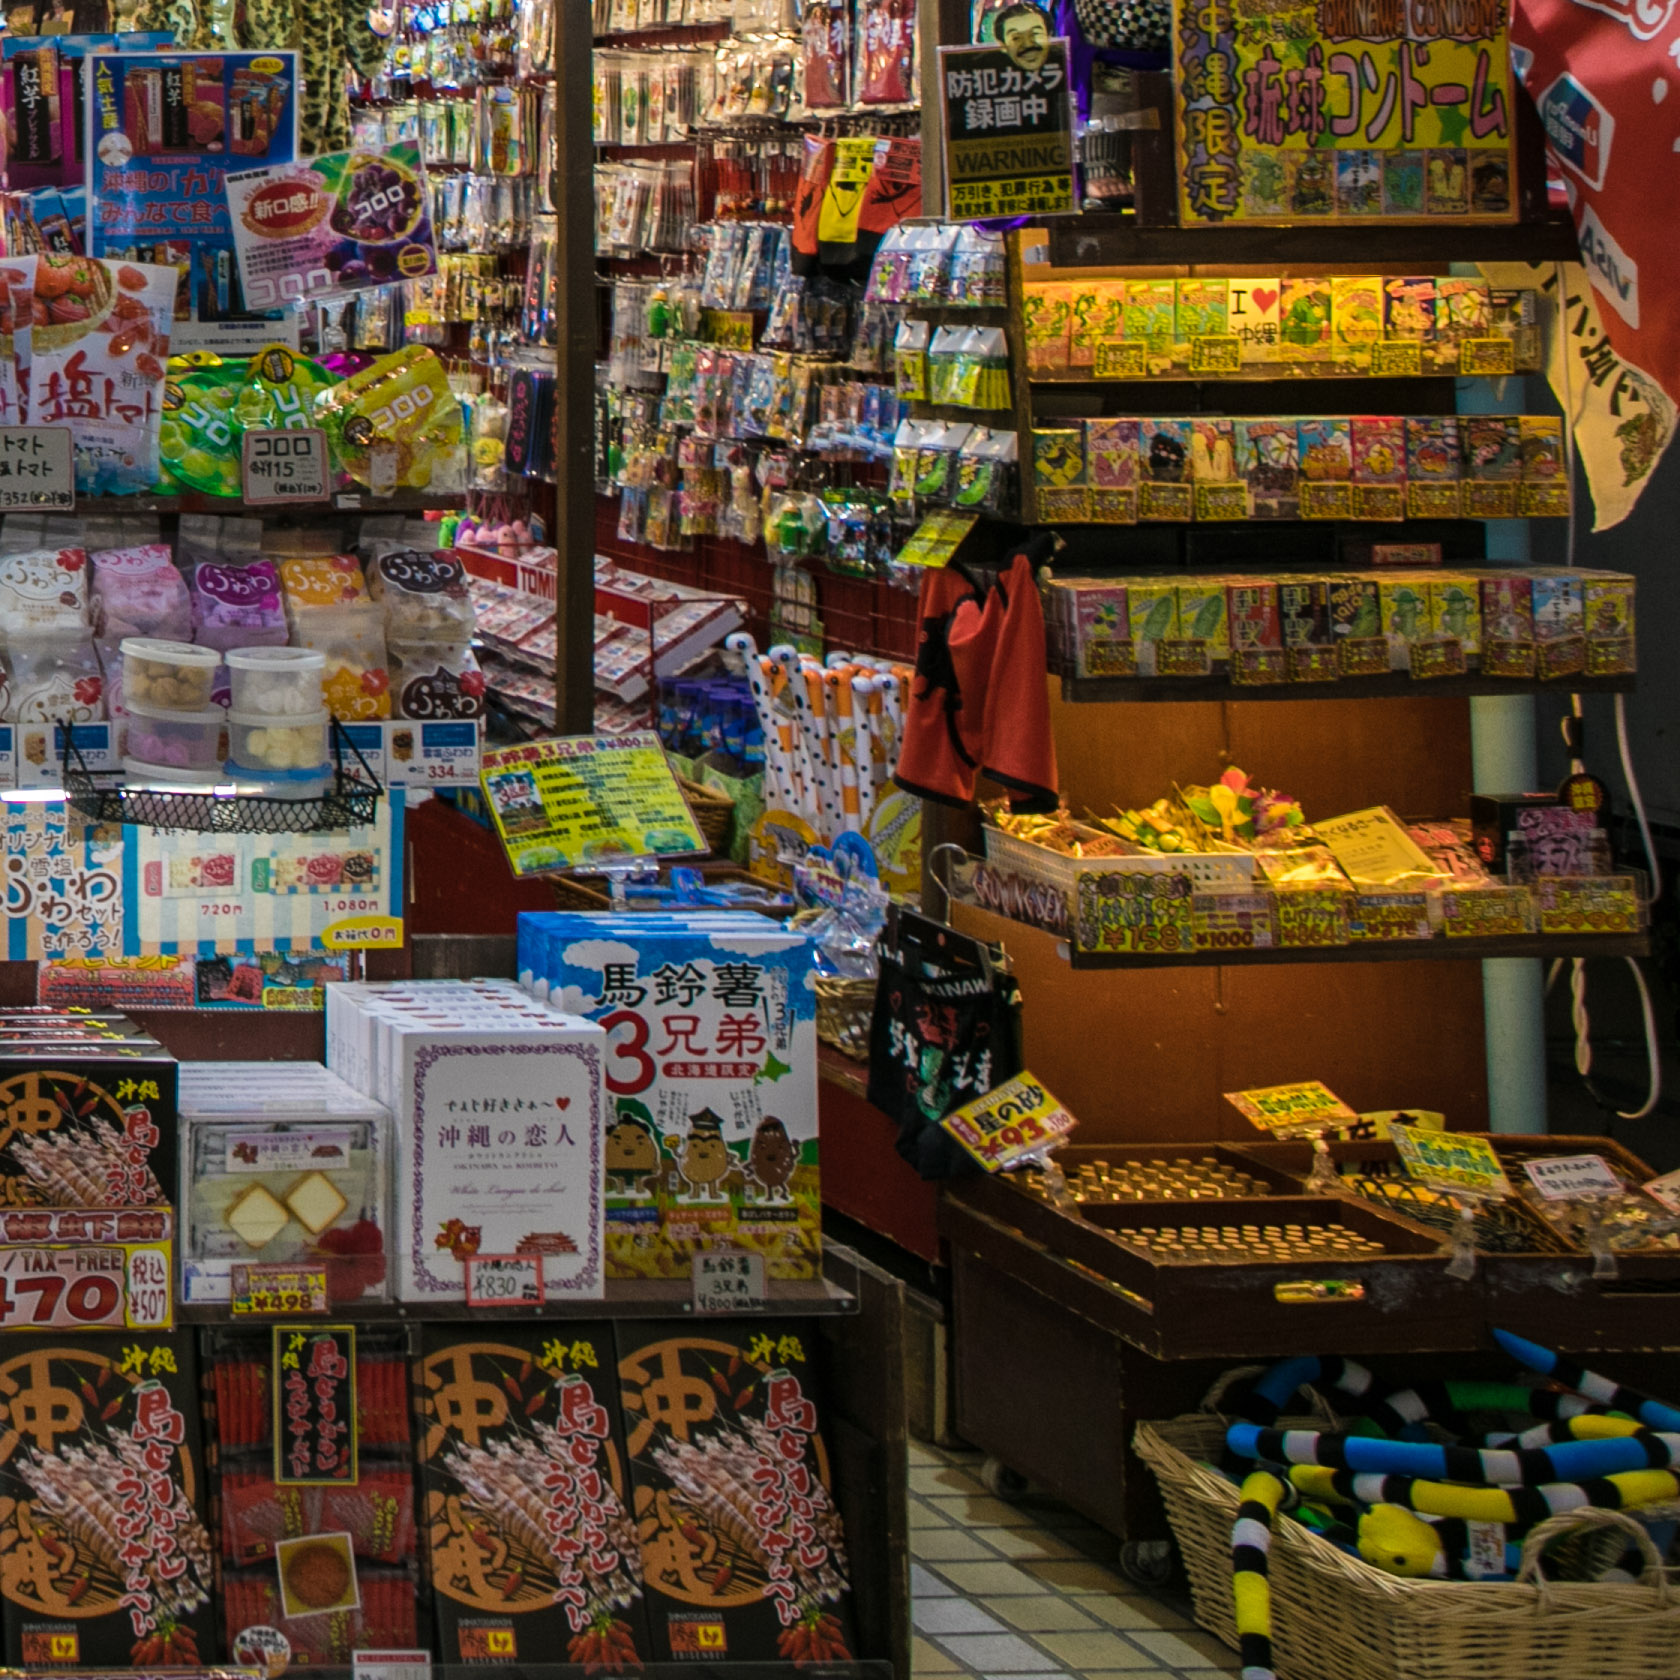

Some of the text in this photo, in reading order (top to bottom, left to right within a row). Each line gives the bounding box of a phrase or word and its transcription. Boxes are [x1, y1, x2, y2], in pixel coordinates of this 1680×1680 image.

[947, 63, 1064, 98] 防犯カメラ
[1244, 42, 1508, 146] 琉球コンドーム
[965, 95, 1048, 130] 録画中
[956, 144, 1066, 173] WARNING
[354, 185, 405, 220] コロロ
[1230, 323, 1277, 348] 沖縄
[255, 436, 312, 457] コロロ
[429, 767, 460, 782] 334
[29, 856, 73, 878] 雪塩
[75, 905, 123, 923] セット
[322, 898, 379, 913] 1,080円
[43, 927, 122, 952] を作ろう!
[1102, 925, 1180, 950] ¥158
[599, 962, 766, 1009] 馬鈴薯
[658, 1014, 769, 1059] 兄弟
[668, 1063, 752, 1079] 北海道限定
[116, 1079, 160, 1102] 沖縄
[438, 1124, 576, 1148] 沖縄の恋人
[21, 1250, 123, 1272] TAX-FREE
[132, 1254, 166, 1287] 税込
[129, 1289, 167, 1324] ¥507
[120, 1344, 179, 1377] 沖縄
[541, 1338, 600, 1369] 沖縄
[749, 1333, 807, 1365] 沖縄
